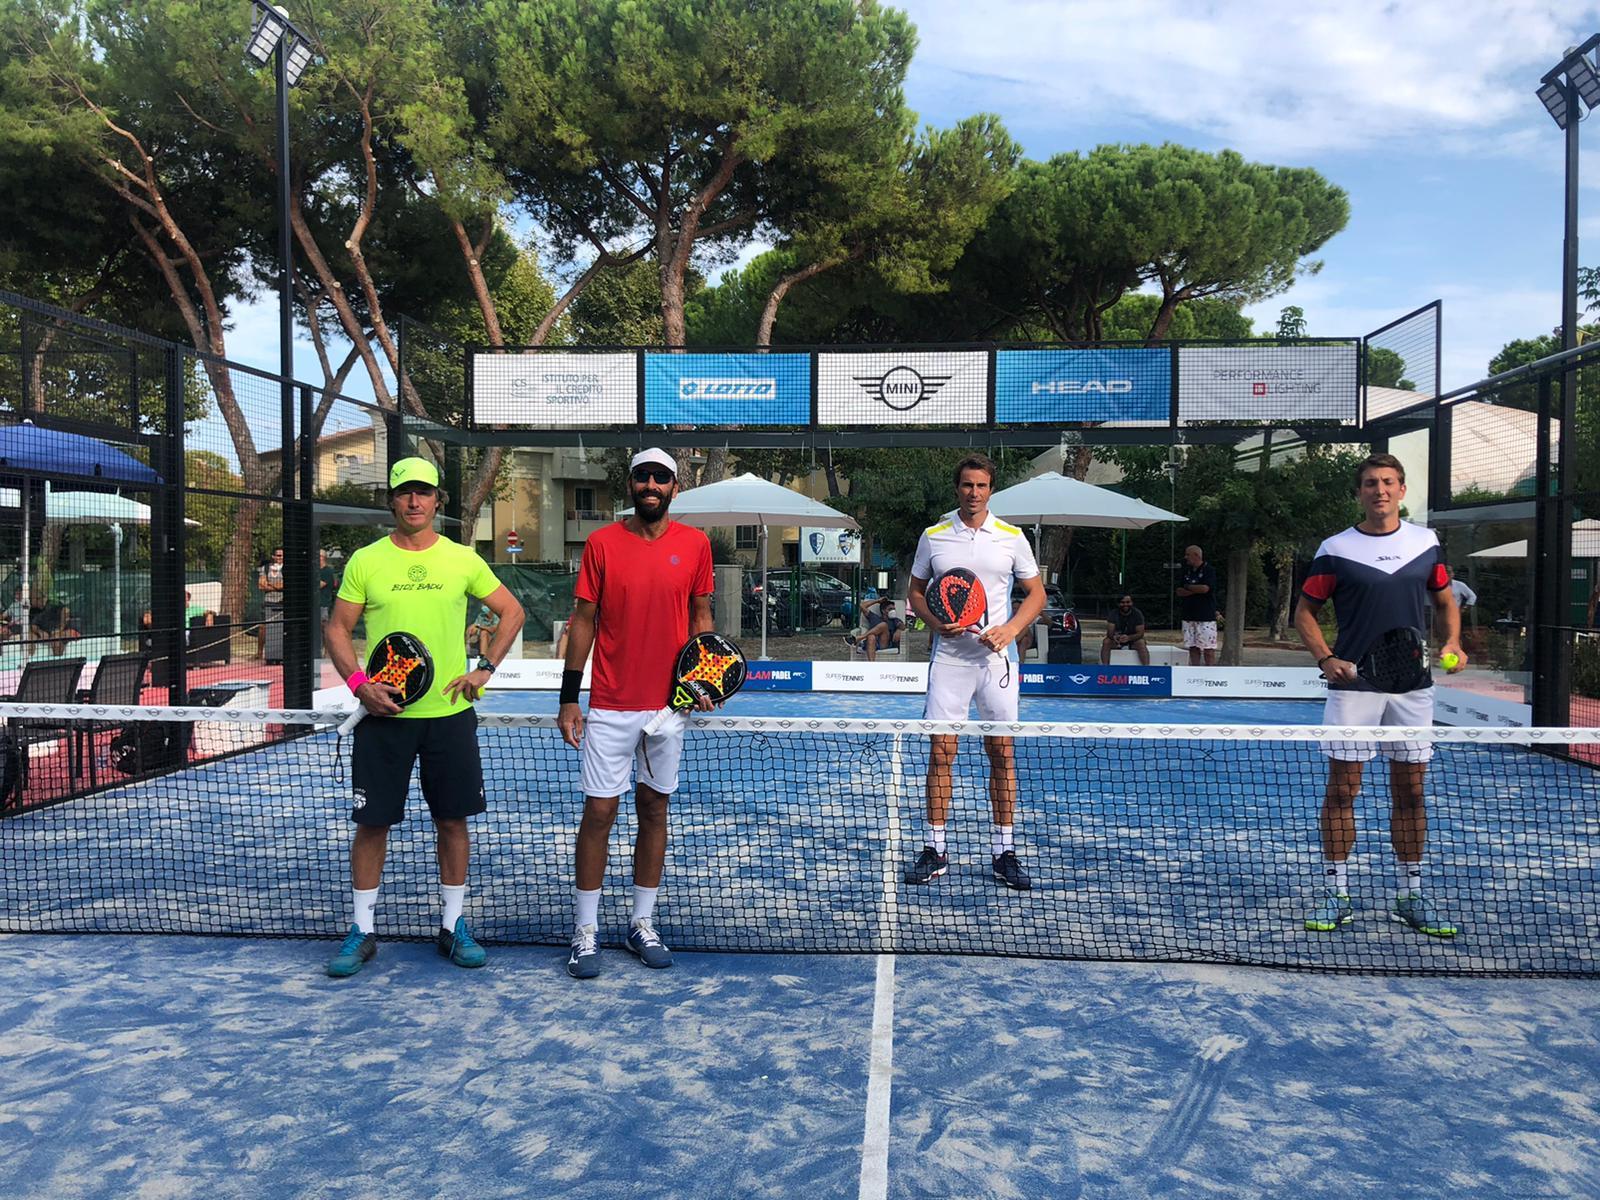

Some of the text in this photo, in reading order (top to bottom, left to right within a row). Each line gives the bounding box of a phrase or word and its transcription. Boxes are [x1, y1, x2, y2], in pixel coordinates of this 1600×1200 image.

[542, 374, 599, 383] ISTITUTO PER
[1213, 369, 1304, 380] PERFORMANCE
[566, 384, 603, 394] CREDITO
[886, 383, 918, 394] MINI
[1031, 380, 1133, 394] HEAD
[1267, 383, 1321, 393] LIGHTING
